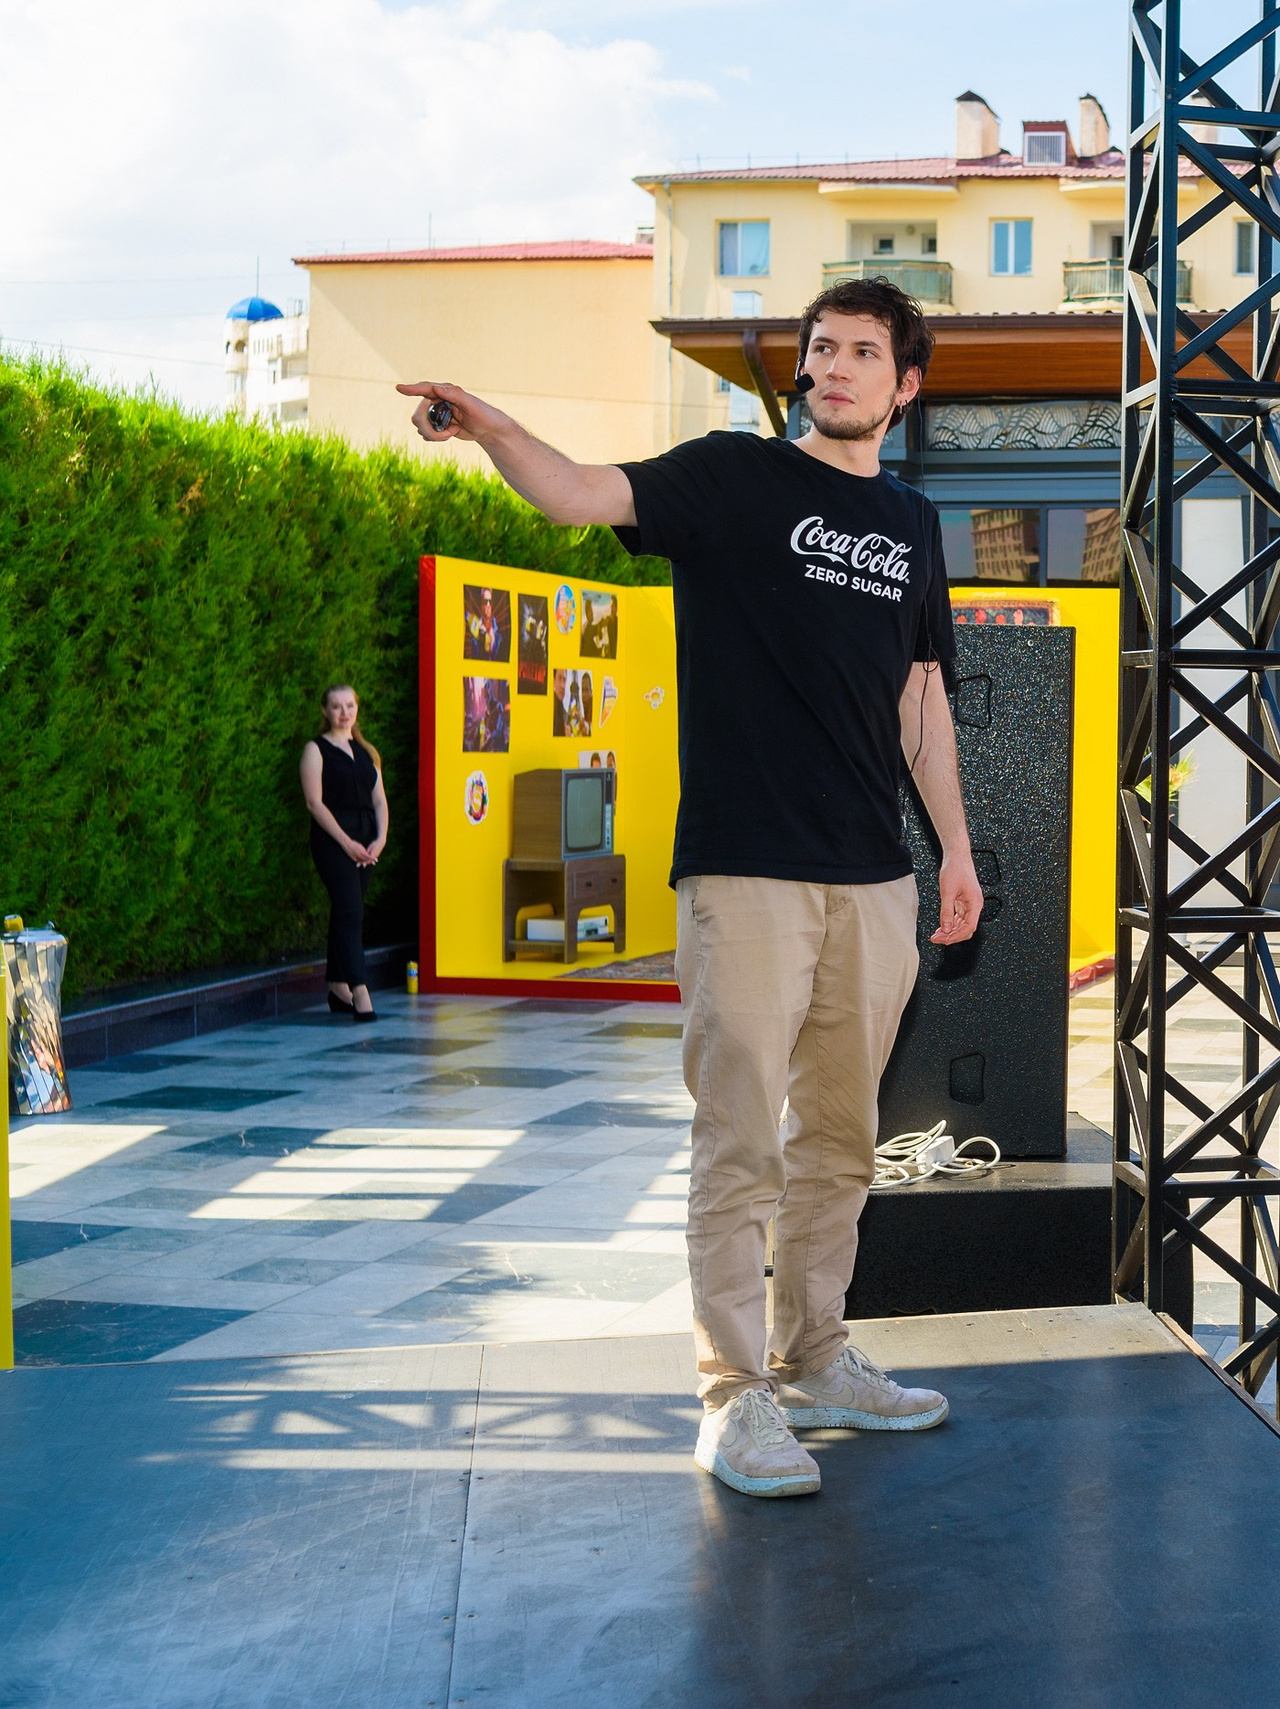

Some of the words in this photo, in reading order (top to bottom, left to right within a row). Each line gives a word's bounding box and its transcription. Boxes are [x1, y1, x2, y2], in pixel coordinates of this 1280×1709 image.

[790, 516, 912, 581] Coca-Cola
[804, 564, 848, 586] ZERO
[851, 577, 902, 602] SUGAR
